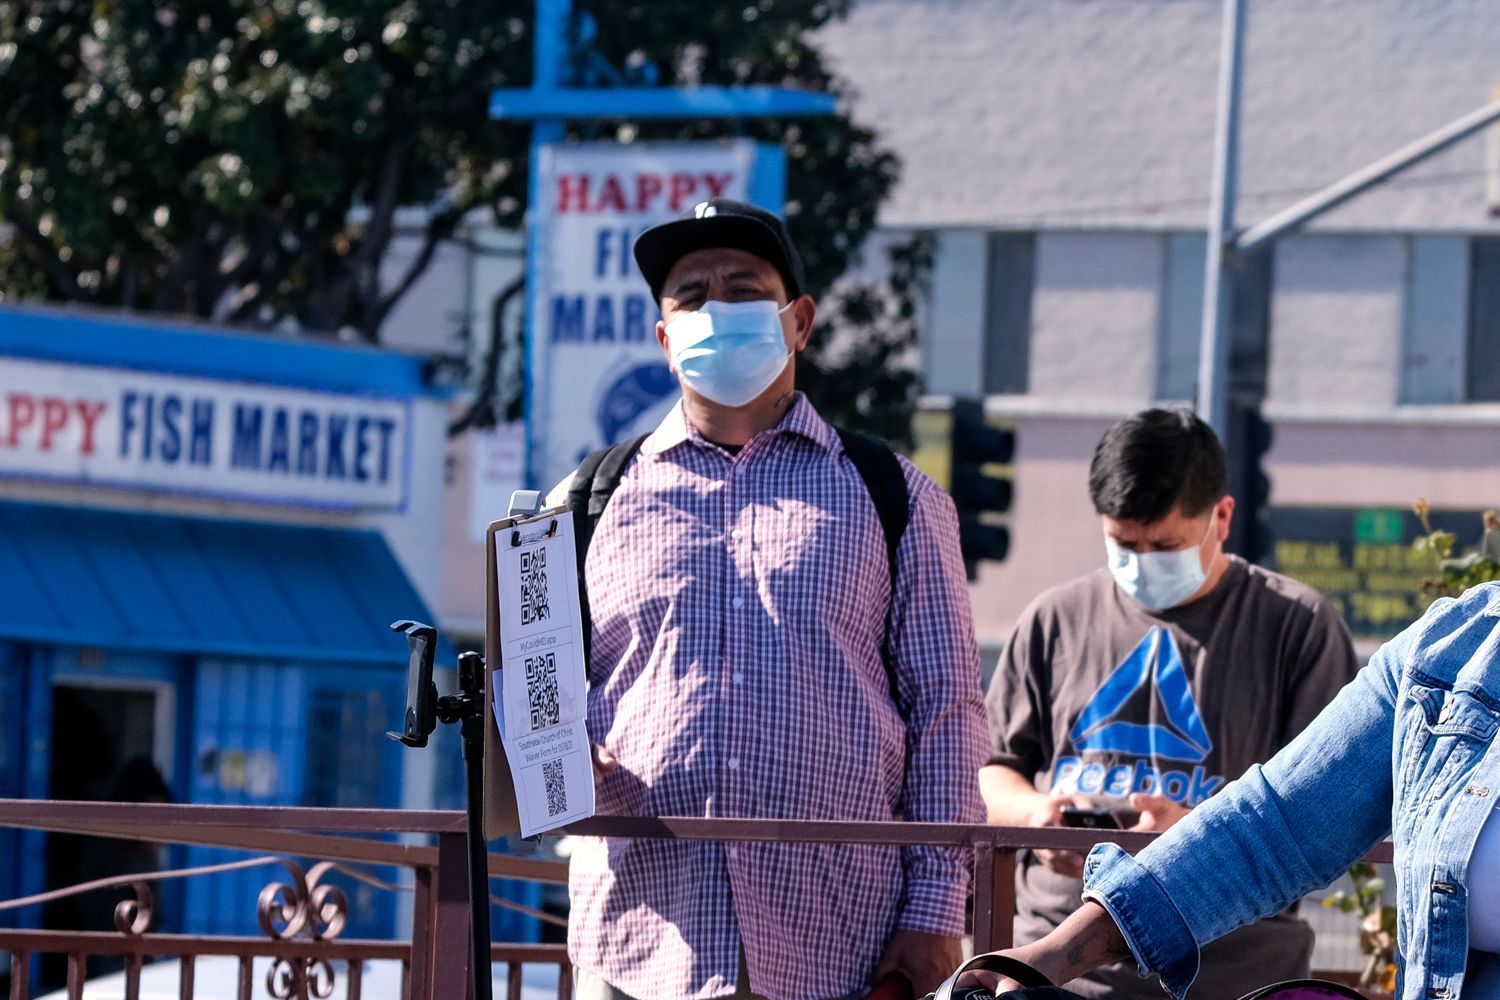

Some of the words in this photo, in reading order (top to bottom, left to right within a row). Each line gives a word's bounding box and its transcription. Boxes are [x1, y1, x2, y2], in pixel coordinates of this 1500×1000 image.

[557, 170, 734, 214] HAPPY
[118, 389, 214, 467] FISH
[230, 402, 396, 484] MARKET
[1050, 755, 1224, 807] Reebok
